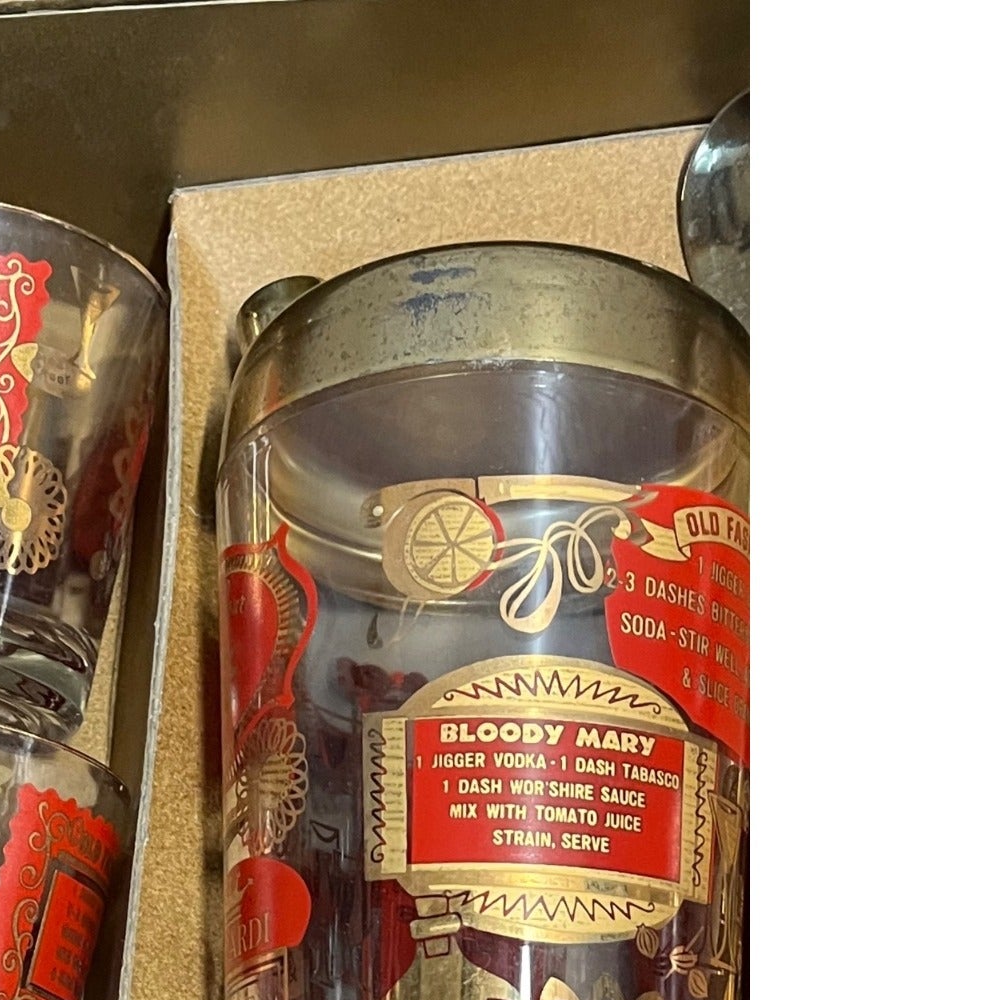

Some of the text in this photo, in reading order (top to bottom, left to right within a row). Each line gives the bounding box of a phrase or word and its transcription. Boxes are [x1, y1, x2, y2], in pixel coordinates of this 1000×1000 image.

[685, 511, 720, 537] OLD
[699, 556, 704, 574] 1
[606, 567, 635, 592] 2-3
[645, 576, 705, 615] DASHES
[682, 667, 730, 706] & SLICE
[440, 722, 655, 756] BLOODY MARY
[417, 755, 421, 769] 1
[432, 752, 486, 769] JIGGER
[575, 757, 615, 777] DASH
[622, 763, 679, 790] TABASCO
[443, 778, 646, 808] 1 DASH WOR'SHIRE SAUCE
[450, 803, 641, 832] MIX WITH TOMATO JUICE
[493, 829, 610, 853] STRAIN, SERVE
